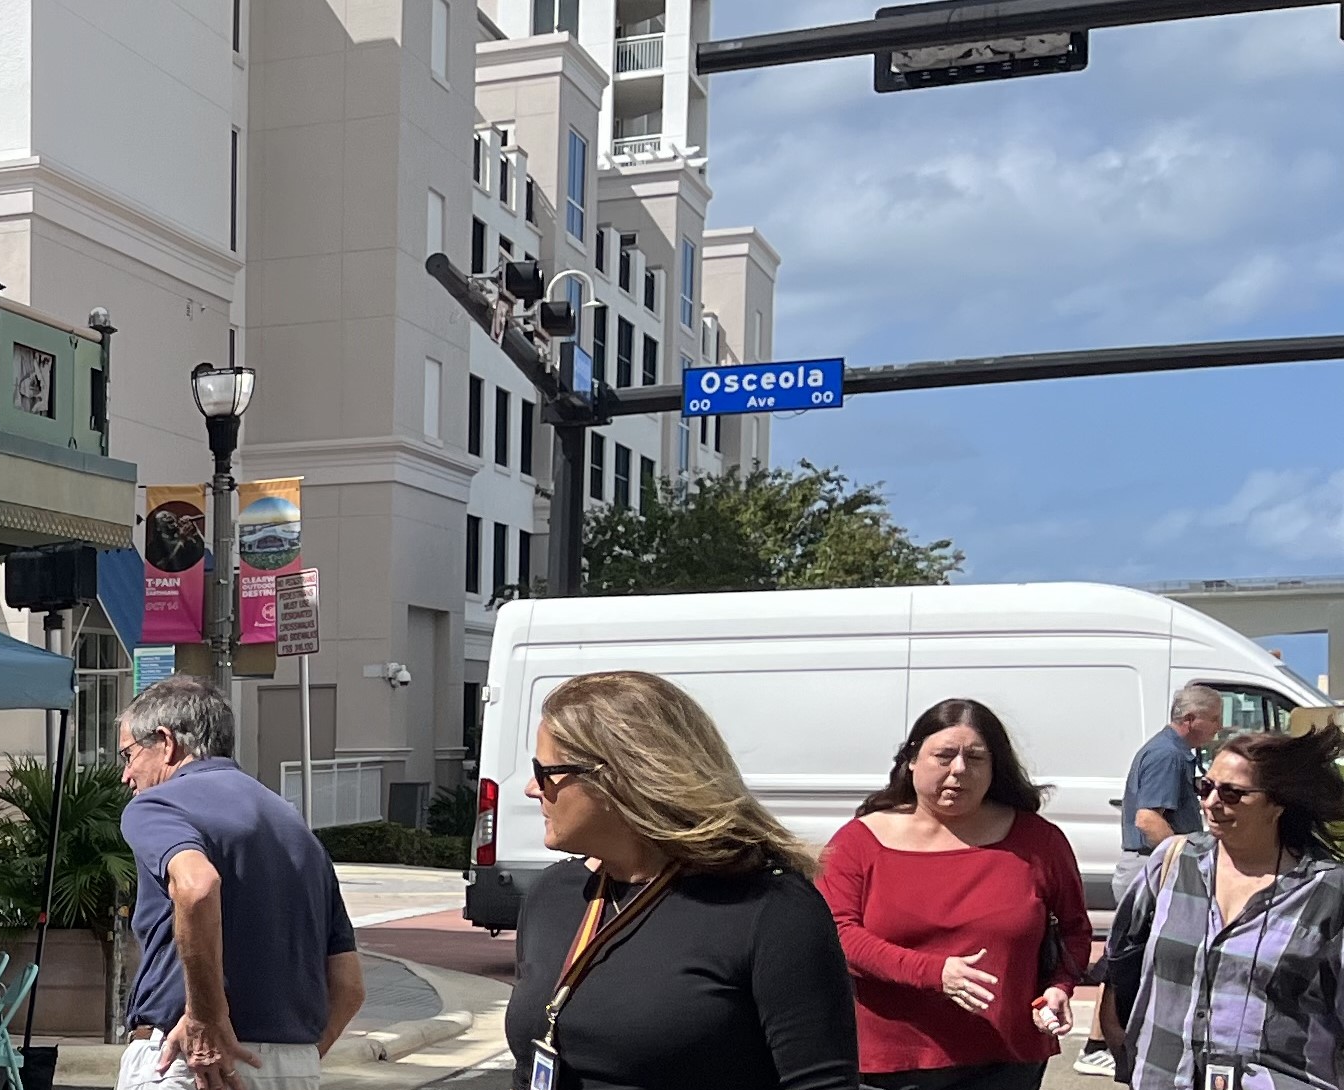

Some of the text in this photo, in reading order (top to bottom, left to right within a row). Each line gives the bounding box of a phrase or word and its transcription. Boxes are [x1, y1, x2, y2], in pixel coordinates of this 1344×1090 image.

[700, 366, 824, 394] Osceola
[689, 391, 834, 411] 00 Ave 00
